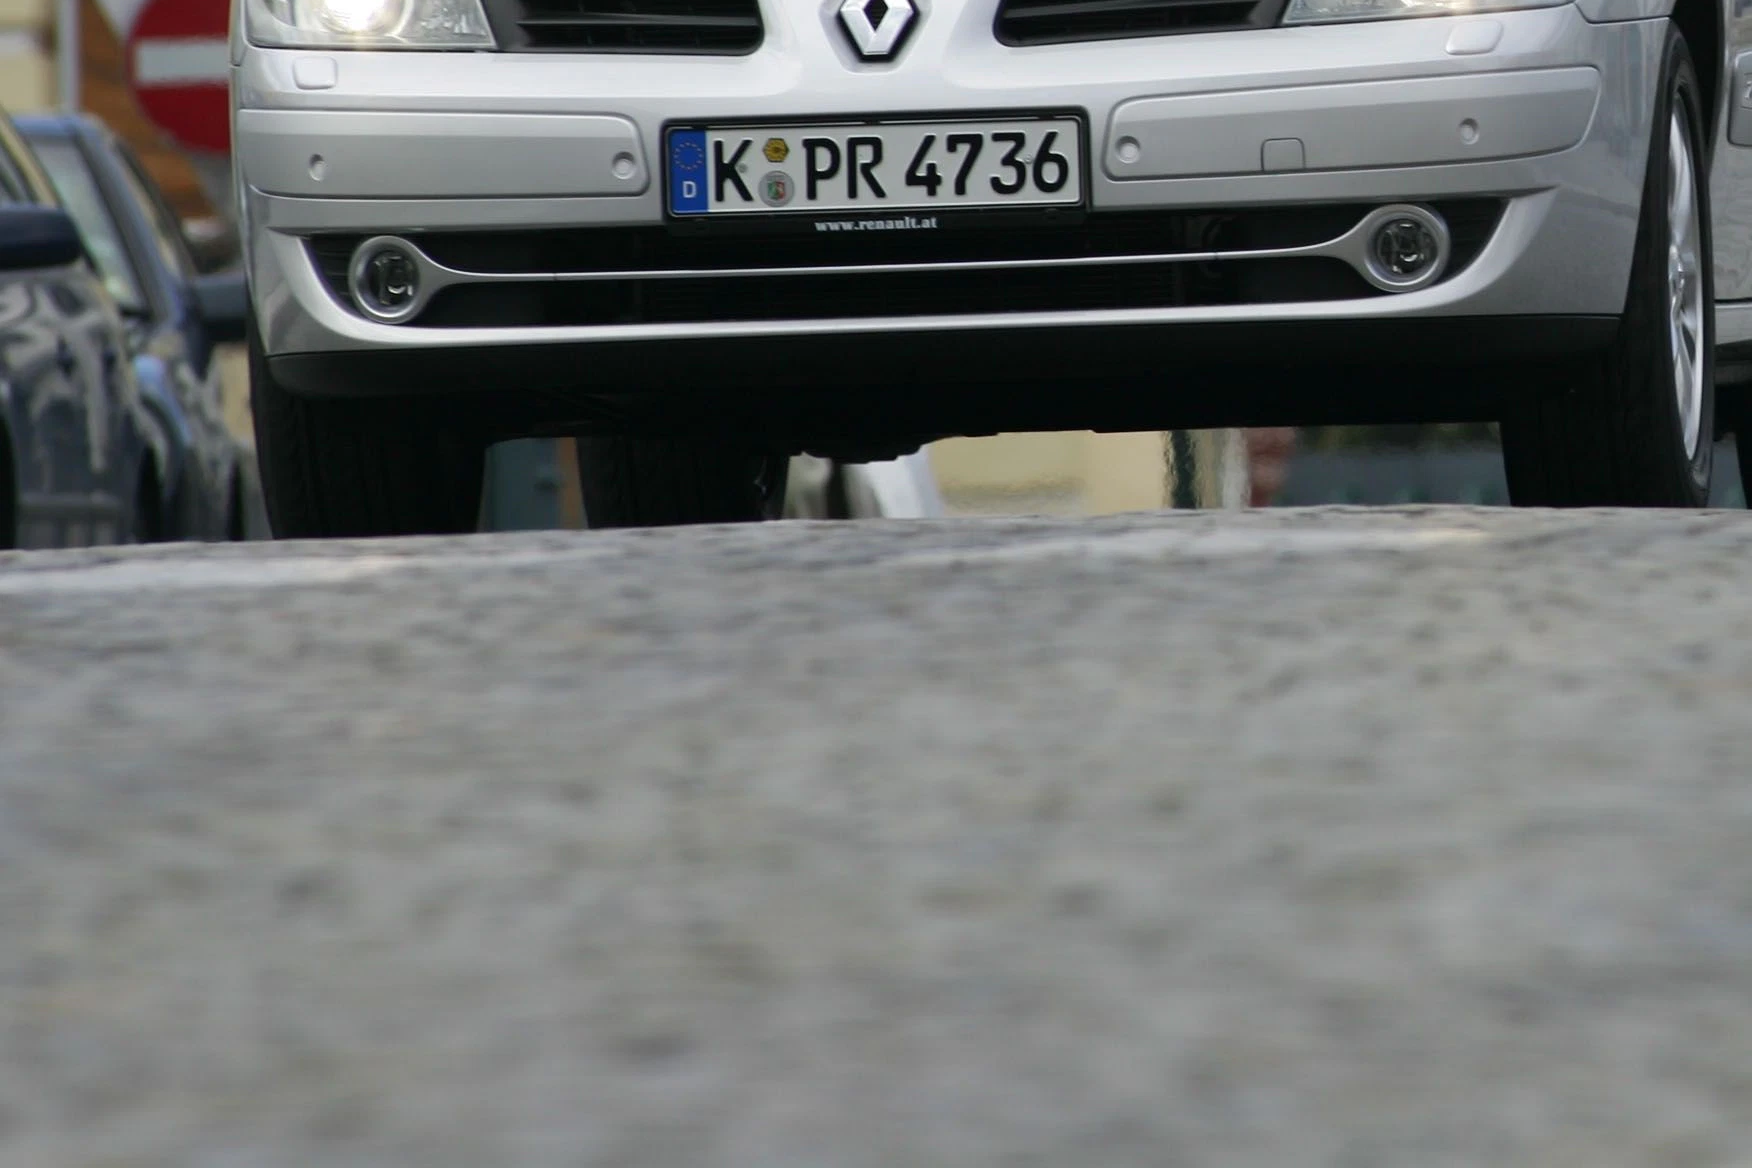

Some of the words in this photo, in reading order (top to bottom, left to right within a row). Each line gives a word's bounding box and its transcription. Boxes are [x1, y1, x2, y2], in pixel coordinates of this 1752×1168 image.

[714, 139, 754, 202] K
[802, 137, 887, 200] PR
[905, 131, 1069, 197] 4736
[682, 180, 697, 199] D
[814, 216, 938, 232] www.renault.at
